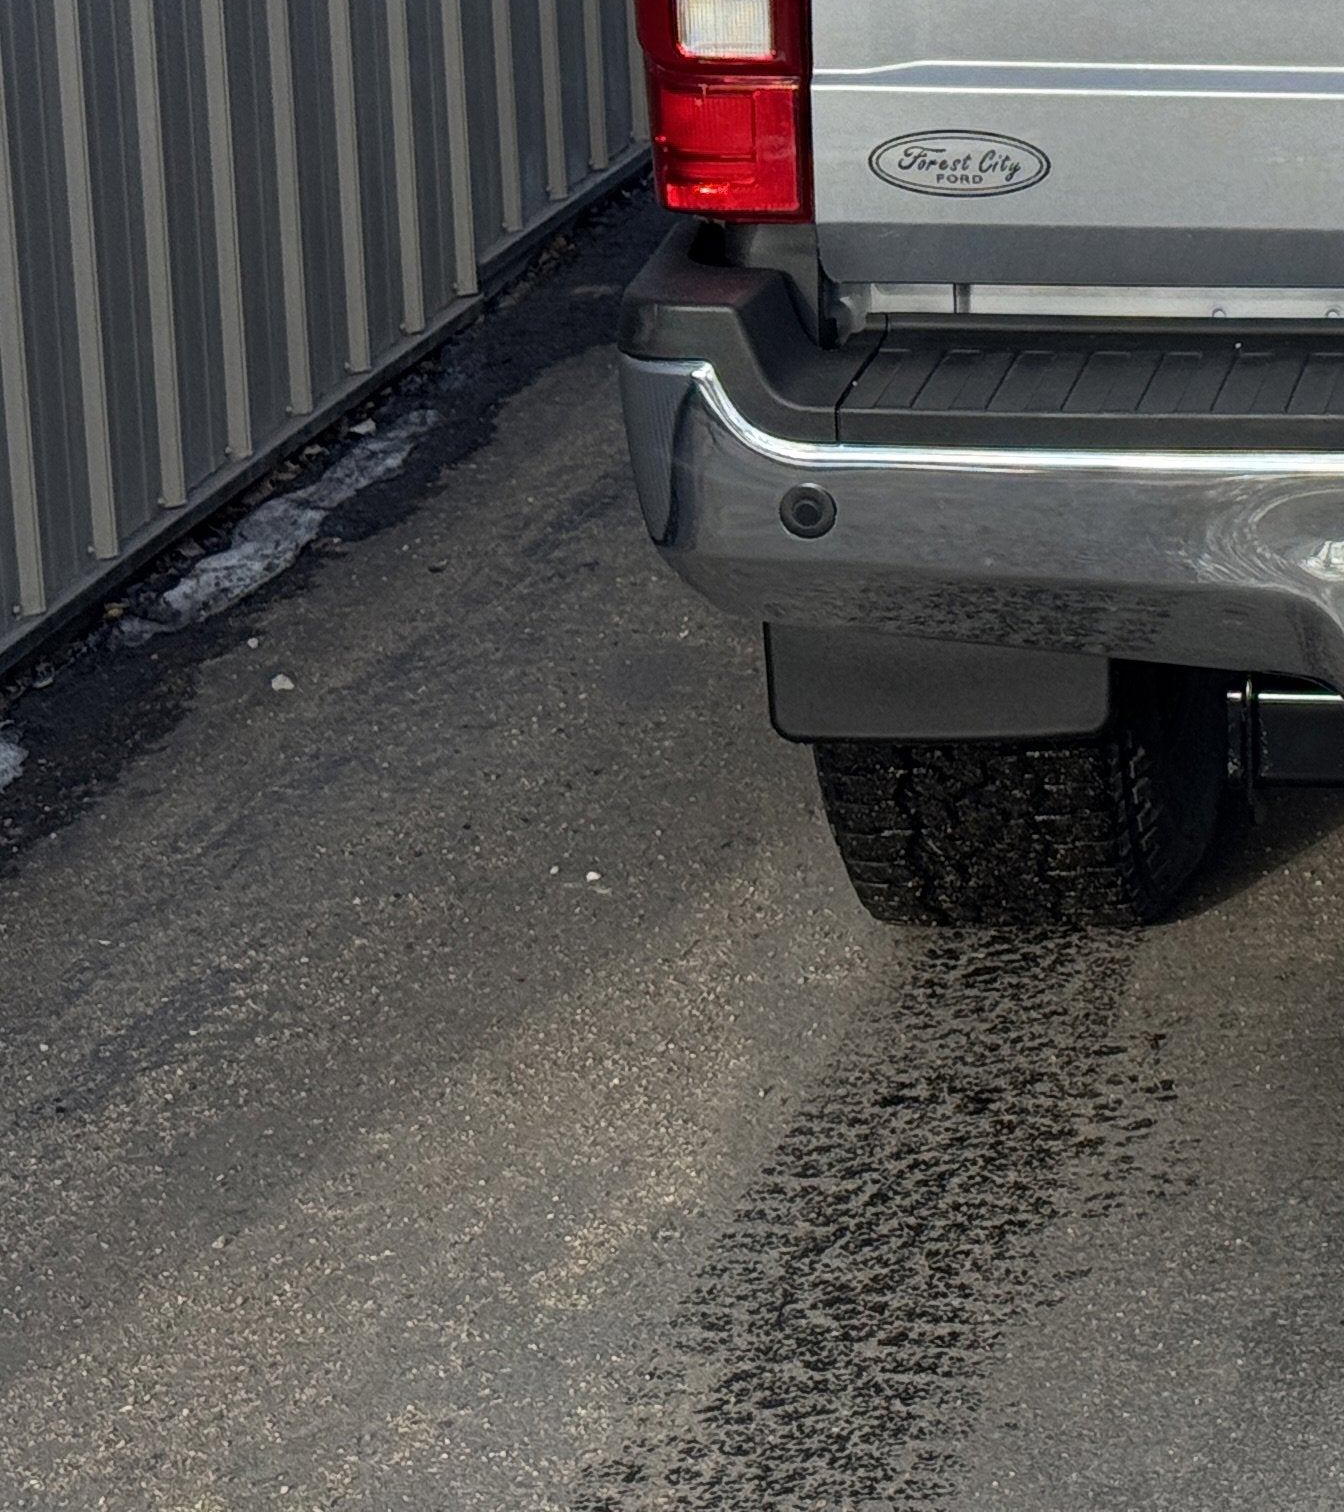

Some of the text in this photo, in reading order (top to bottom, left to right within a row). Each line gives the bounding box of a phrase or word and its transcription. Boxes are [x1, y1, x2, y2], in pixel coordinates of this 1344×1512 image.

[898, 146, 1022, 182] Forest City
[936, 174, 984, 184] FORD
